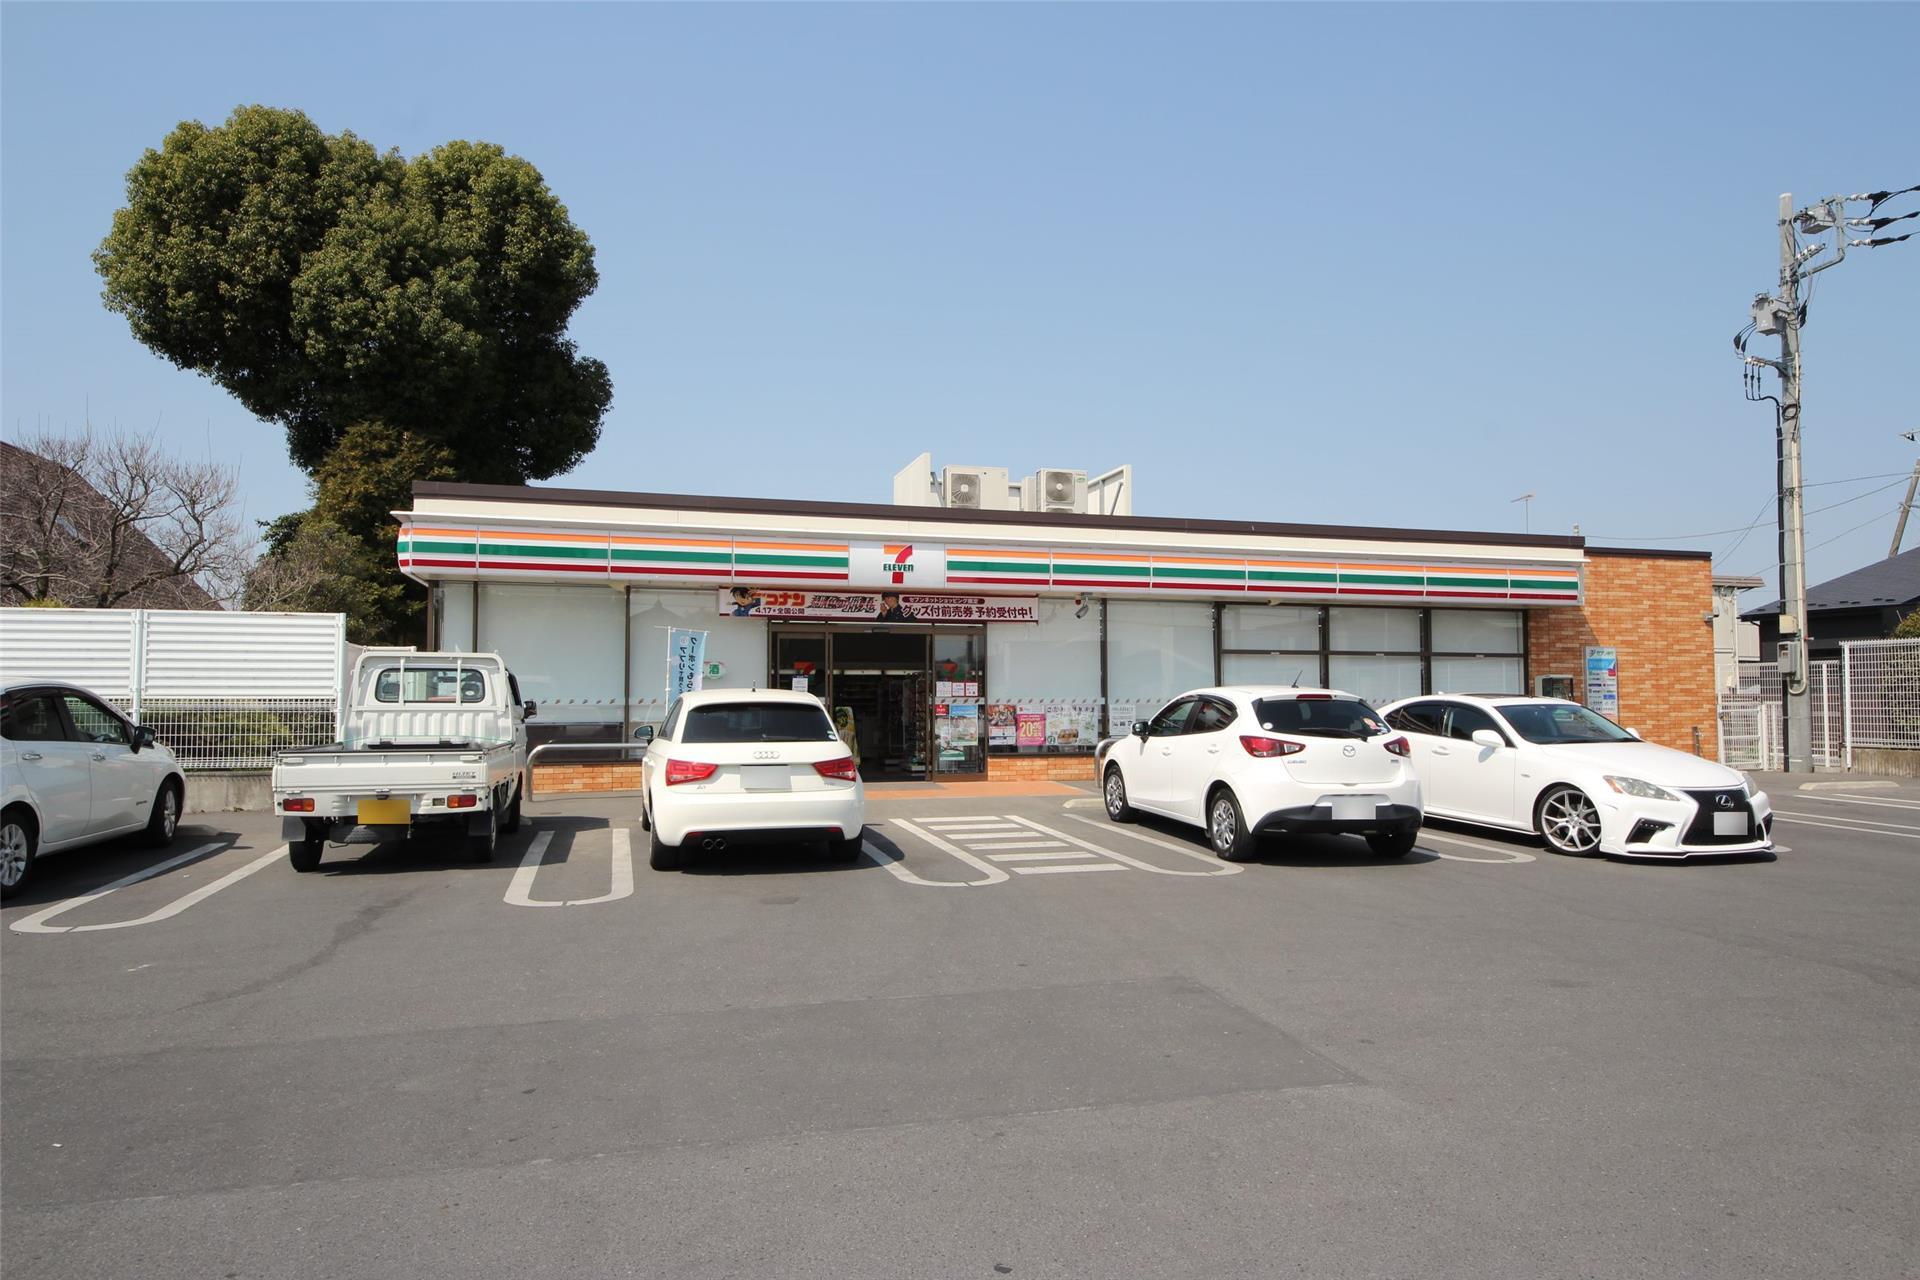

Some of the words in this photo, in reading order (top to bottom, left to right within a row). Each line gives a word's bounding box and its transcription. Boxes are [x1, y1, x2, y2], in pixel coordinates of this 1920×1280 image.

[884, 544, 913, 584] 7
[764, 592, 806, 607] コナン
[902, 604, 974, 617] グッズ付前売券
